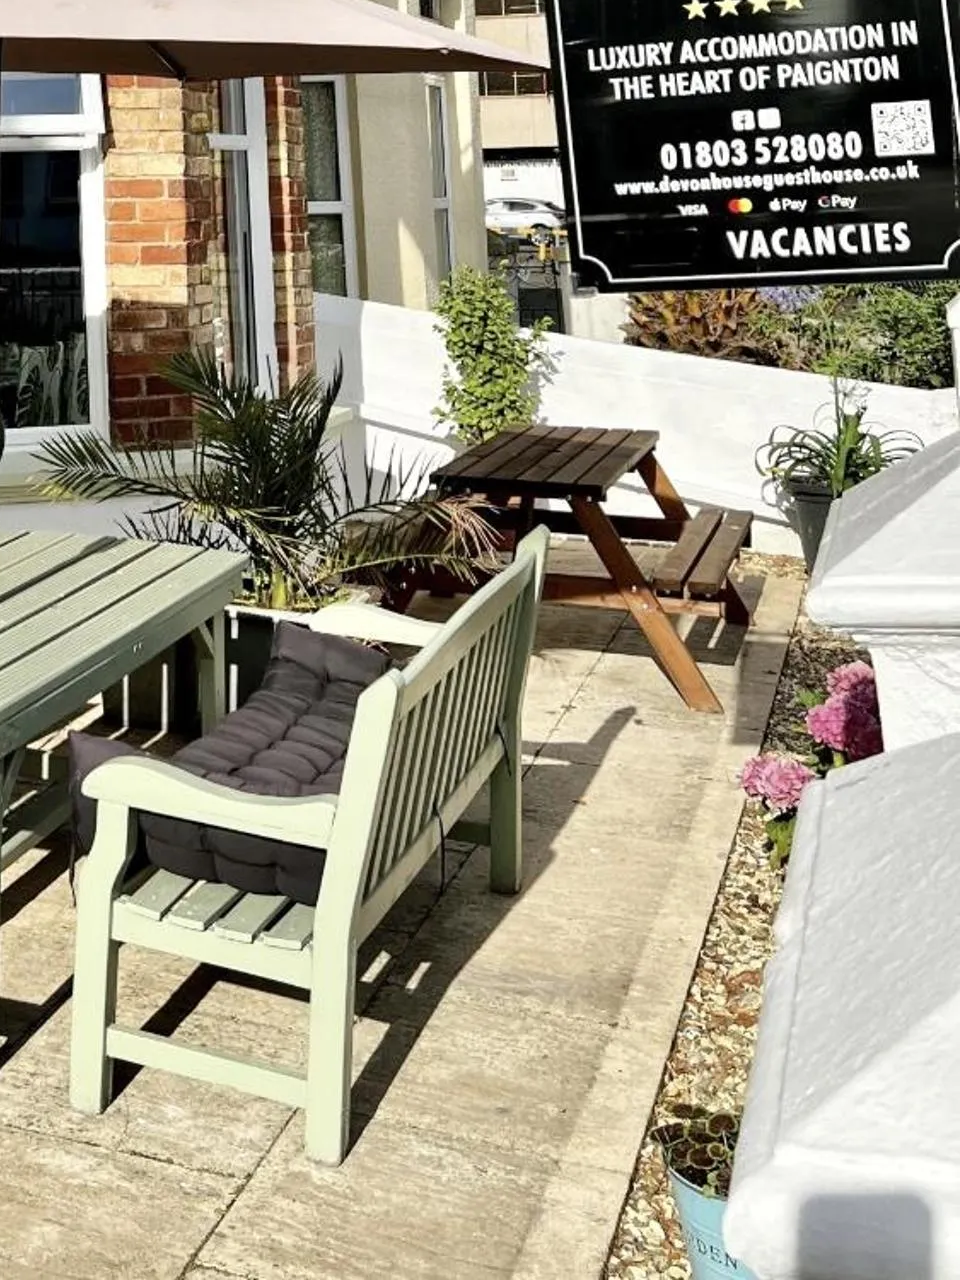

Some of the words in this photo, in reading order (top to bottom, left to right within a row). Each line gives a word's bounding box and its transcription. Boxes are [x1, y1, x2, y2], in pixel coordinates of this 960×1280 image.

[587, 41, 674, 72] LUXURY
[679, 23, 885, 65] ACCOMMODATION
[890, 19, 919, 47] IN
[608, 75, 656, 101] THE
[658, 68, 734, 98] HEART
[739, 65, 771, 92] OF
[776, 54, 901, 89] PAIGNTON
[660, 137, 748, 171] 01803
[754, 130, 863, 166] 528080
[613, 159, 920, 197] www.devonhouseguesthouse.co.uk
[676, 203, 709, 217] VISA
[781, 197, 808, 214] Pay
[726, 221, 912, 260] VACANCIES
